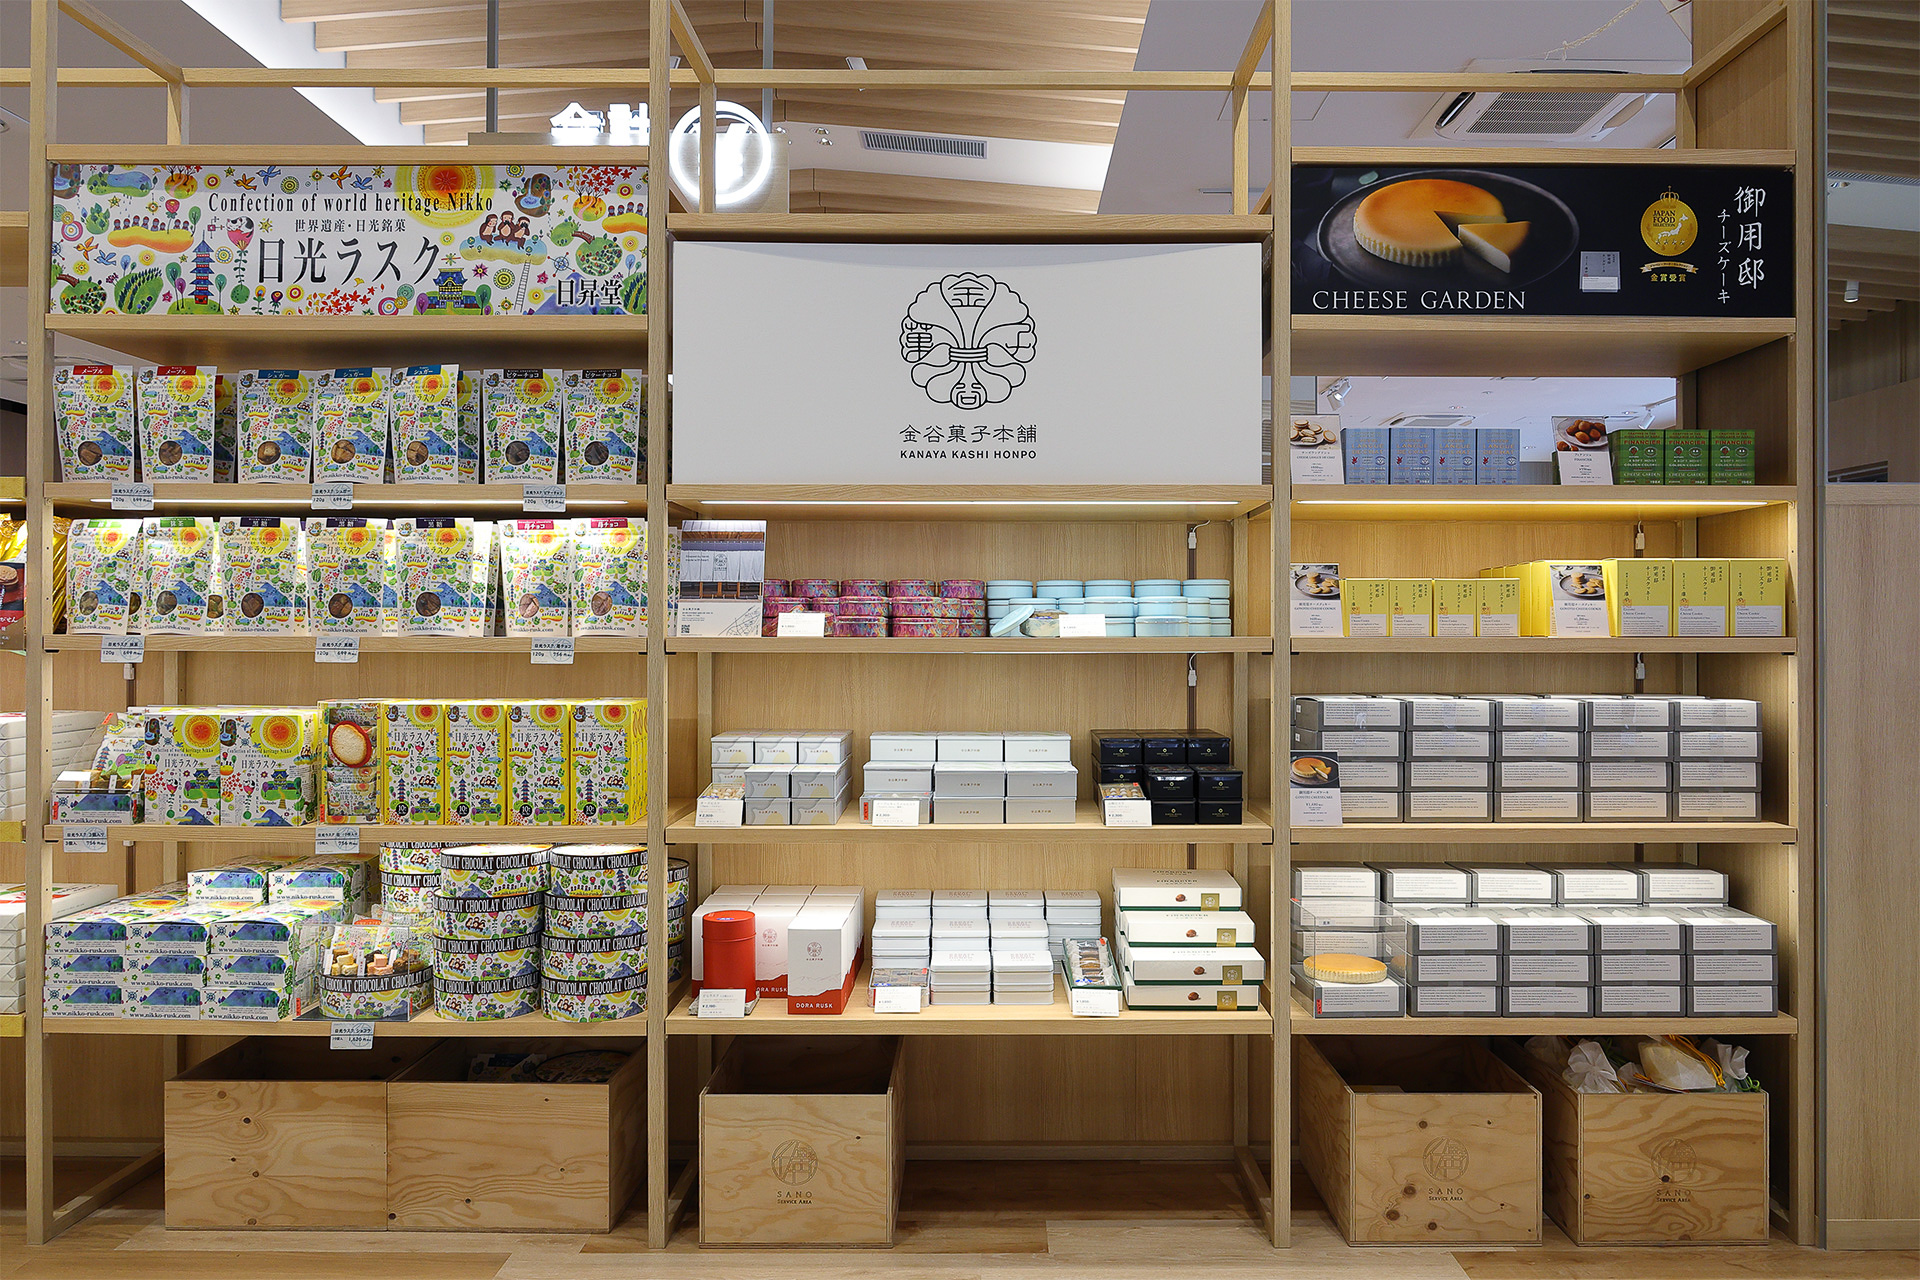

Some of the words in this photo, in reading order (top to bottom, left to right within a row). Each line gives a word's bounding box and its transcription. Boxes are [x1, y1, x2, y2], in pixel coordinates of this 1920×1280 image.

[208, 192, 294, 213] Confection
[301, 192, 319, 213] of
[323, 193, 368, 212] world
[375, 192, 441, 216] heritage
[447, 193, 493, 212] Nikko
[295, 218, 407, 234] 世界遺産・日光銘菓
[1733, 185, 1767, 290] 御用邸
[257, 236, 441, 286] 日光ラスク
[1717, 208, 1731, 305] チーズケーキ
[1650, 273, 1687, 282] 金賞受賞
[556, 279, 623, 308] 日昇堂
[948, 278, 989, 307] 金
[1311, 290, 1409, 311] CHEESE
[1421, 290, 1526, 311] GARDEN
[900, 424, 1038, 444] 金谷菓子本舗
[900, 450, 948, 459] KANAYA
[951, 450, 989, 459] KASHI
[993, 450, 1037, 459] HONPO
[394, 731, 431, 741] 日光ラスク
[455, 731, 492, 742] 日光ラスク
[517, 732, 555, 742] 日光ラスク
[581, 732, 619, 742] 日光ラスク
[164, 759, 199, 768] 日光ラスク
[241, 760, 276, 769] 日光ラスク
[461, 856, 494, 870] CHOCOLAT
[495, 855, 529, 869] CHOCOLAT
[572, 856, 605, 870] CHOCOLAT
[606, 853, 639, 869] CHOCOLAT
[394, 874, 421, 887] CHOCOLAT
[465, 899, 500, 912] CHOCOLAT
[501, 896, 532, 910] CHOCOLAT
[556, 898, 585, 911] CHOCOLAT
[586, 896, 621, 911] CHOCOLAT
[133, 947, 196, 955] www.nikko-rusk.com
[448, 940, 479, 954] CHOCOLAT
[480, 938, 515, 953] CHOCOLAT
[549, 940, 575, 953] CHOCOLAT
[577, 939, 611, 953] CHOCOLAT
[612, 936, 640, 950] CHOCOLAT
[326, 979, 352, 992] CHOCOLAT
[354, 977, 390, 992] CHOCOLAT
[391, 970, 422, 989] CHOCOLAT
[445, 981, 475, 994] CHOCOLAT
[476, 979, 511, 994] CHOCOLAT
[557, 982, 587, 995] CHOCOLAT
[589, 979, 623, 994] CHOCOLAT
[208, 1013, 269, 1021] www.nikko-rusk.com
[777, 1190, 813, 1199] SANO
[1428, 1187, 1464, 1195] SANO
